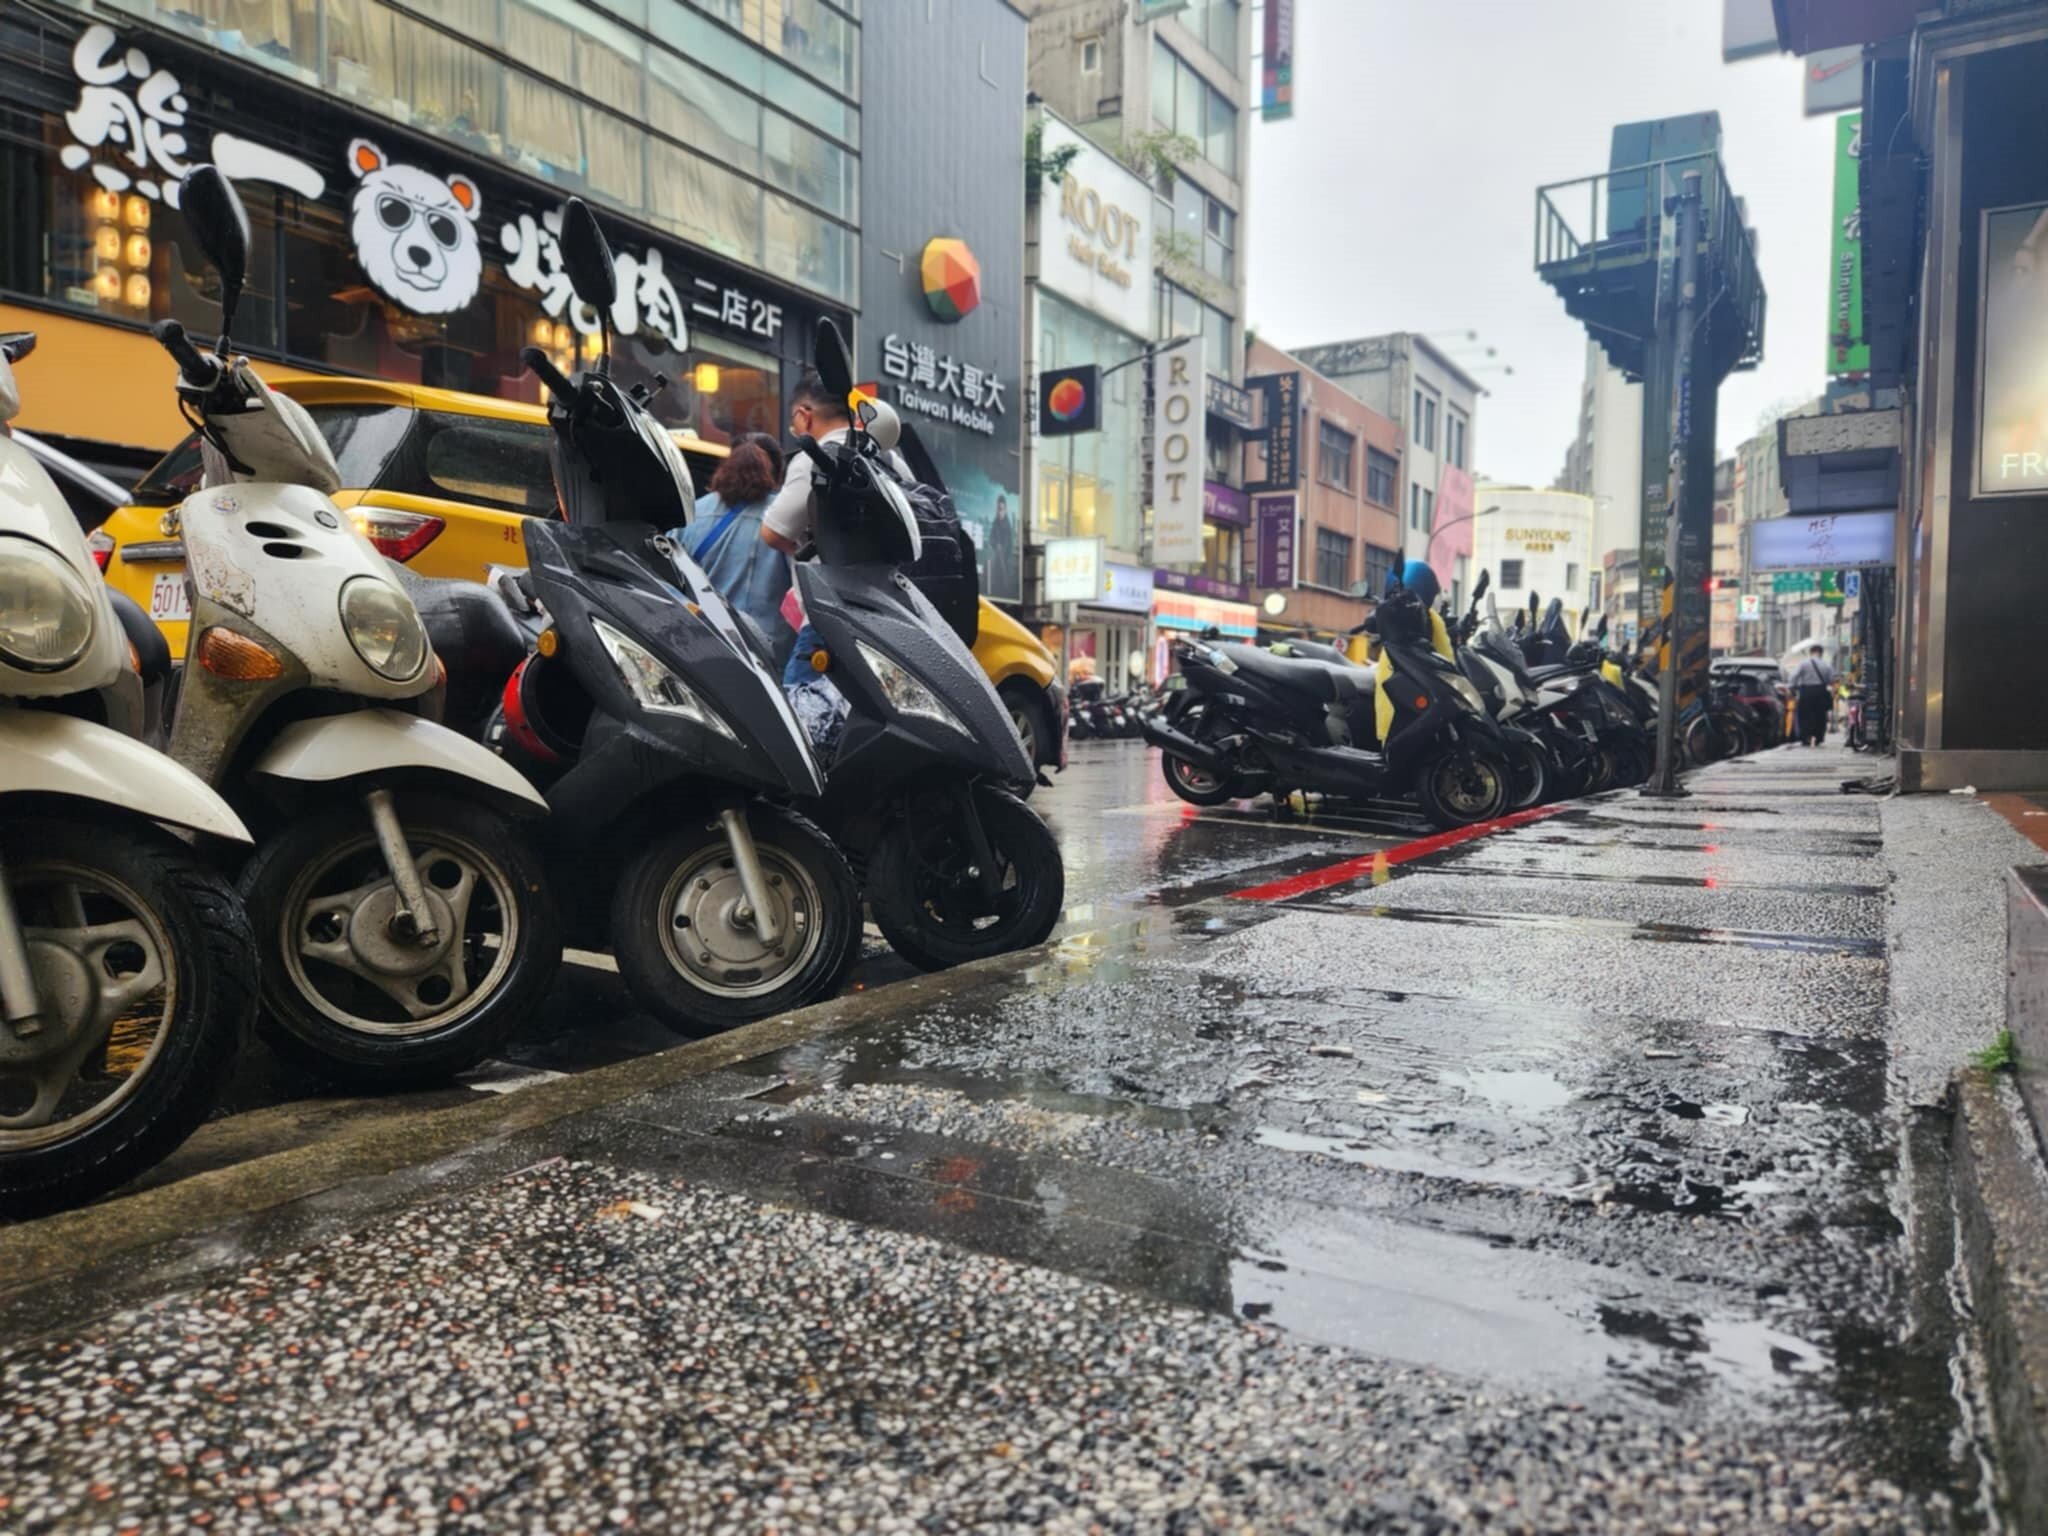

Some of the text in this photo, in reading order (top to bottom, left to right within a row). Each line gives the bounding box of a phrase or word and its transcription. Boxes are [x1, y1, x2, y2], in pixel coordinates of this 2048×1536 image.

[1060, 170, 1140, 261] ROOT
[884, 334, 1006, 414] 台灣大哥大
[897, 384, 995, 435] Taiwan Mobile
[1164, 356, 1190, 502] ROOT
